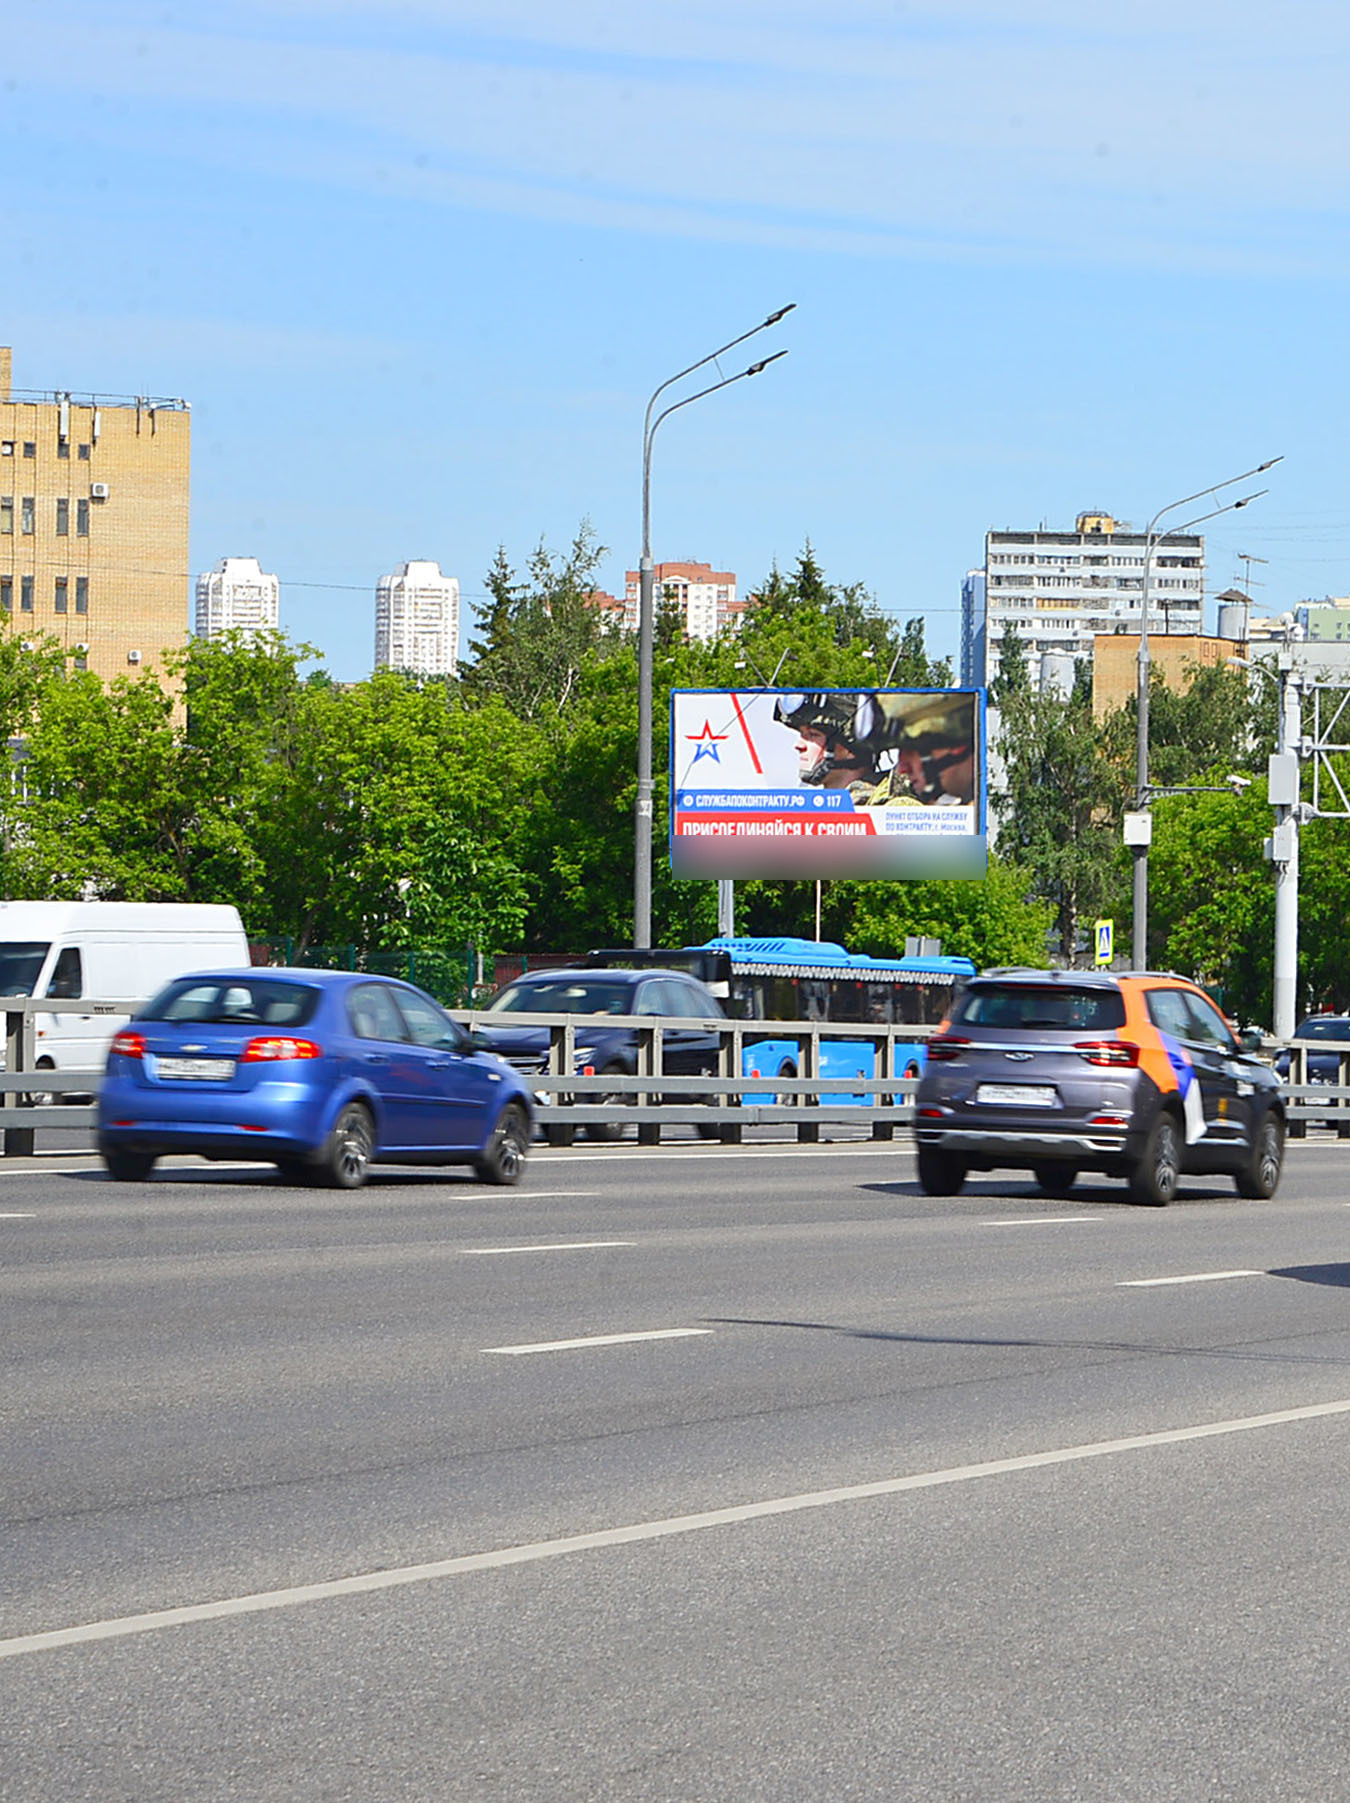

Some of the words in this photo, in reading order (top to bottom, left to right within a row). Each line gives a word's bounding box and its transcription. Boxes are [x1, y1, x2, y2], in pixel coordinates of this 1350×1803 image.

[695, 795, 805, 808] СЛУЖБАПОКОНТРАКТУ.РФ
[827, 795, 842, 807] 117
[817, 823, 867, 835] СВОИМ
